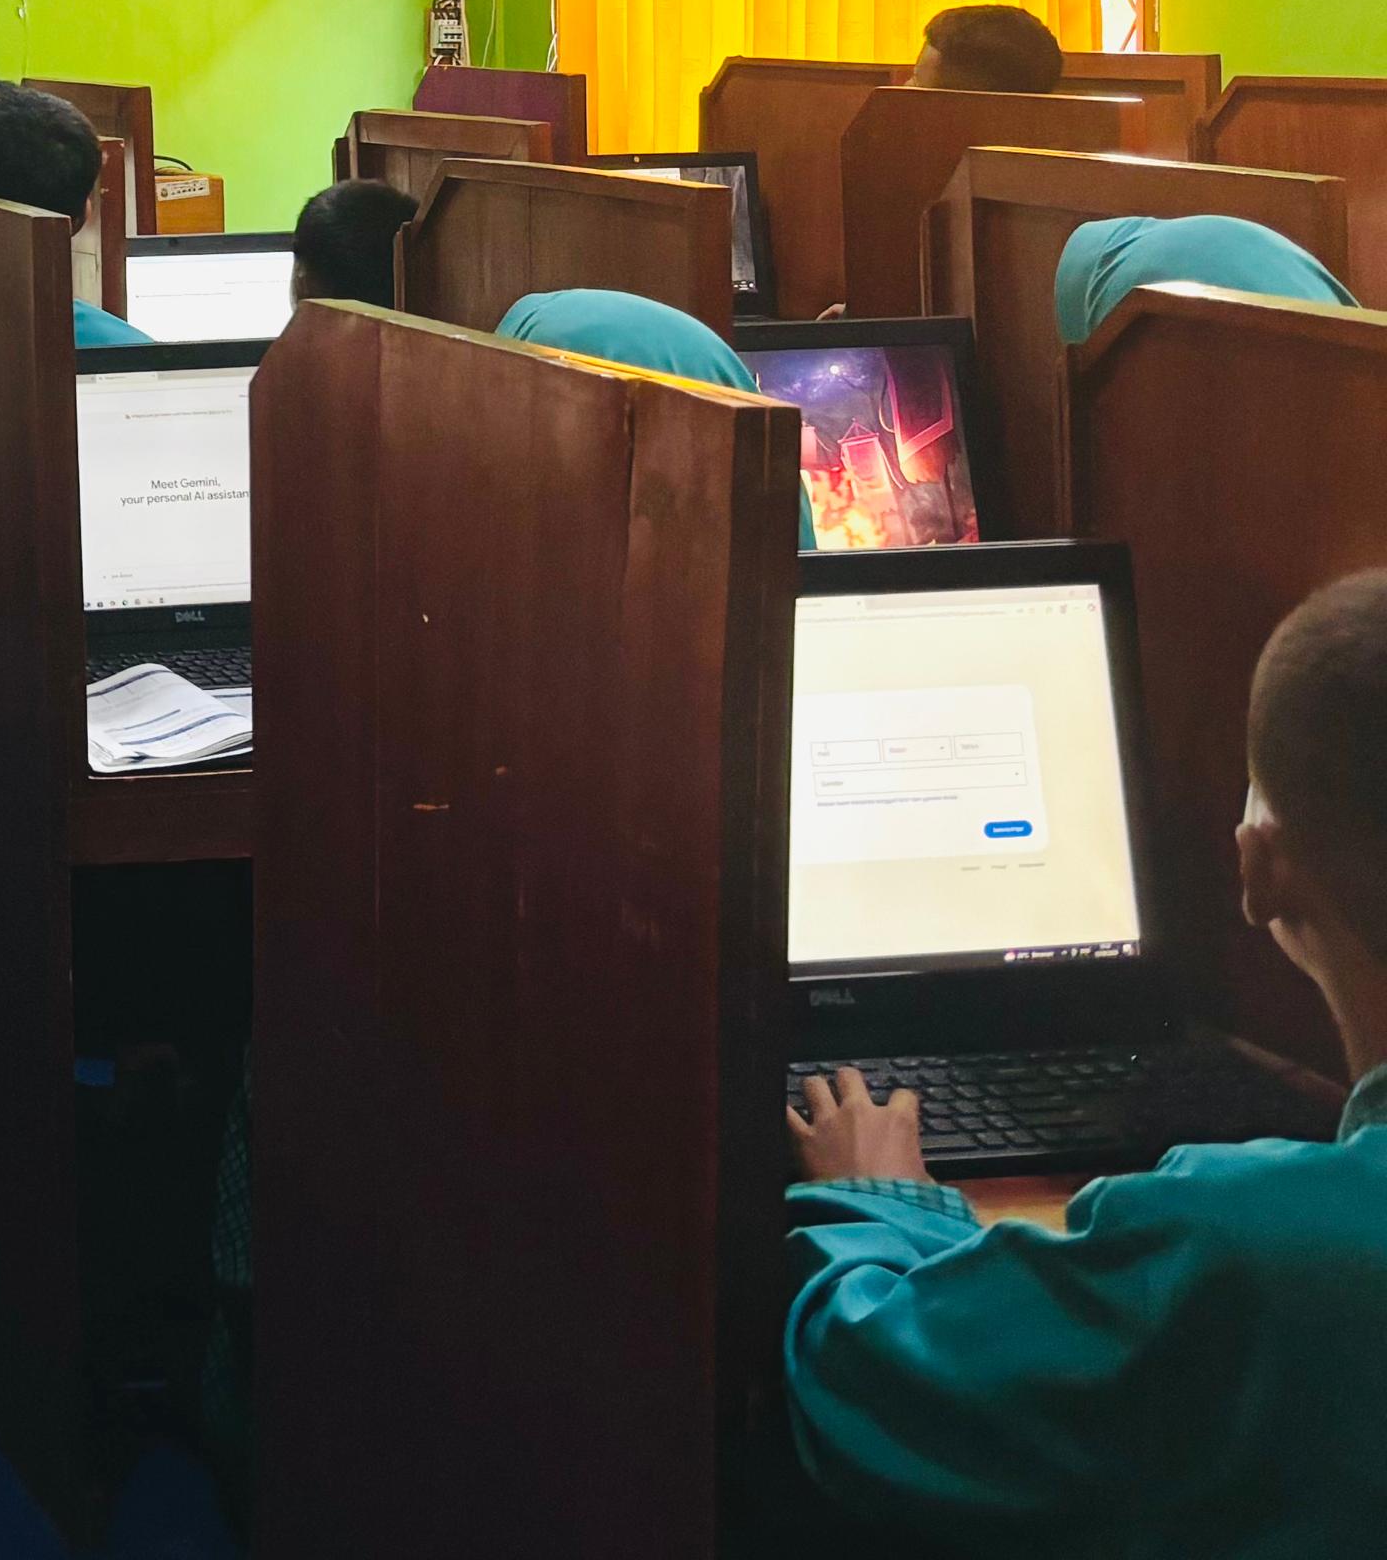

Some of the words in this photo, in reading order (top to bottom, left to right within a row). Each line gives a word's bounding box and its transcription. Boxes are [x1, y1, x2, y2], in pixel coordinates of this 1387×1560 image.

[151, 478, 179, 490] Meet
[180, 476, 221, 489] Gemini,
[120, 496, 145, 507] your
[147, 492, 192, 506] personal
[194, 491, 205, 501] AI
[207, 490, 250, 501] assistan
[175, 610, 205, 623] DELL
